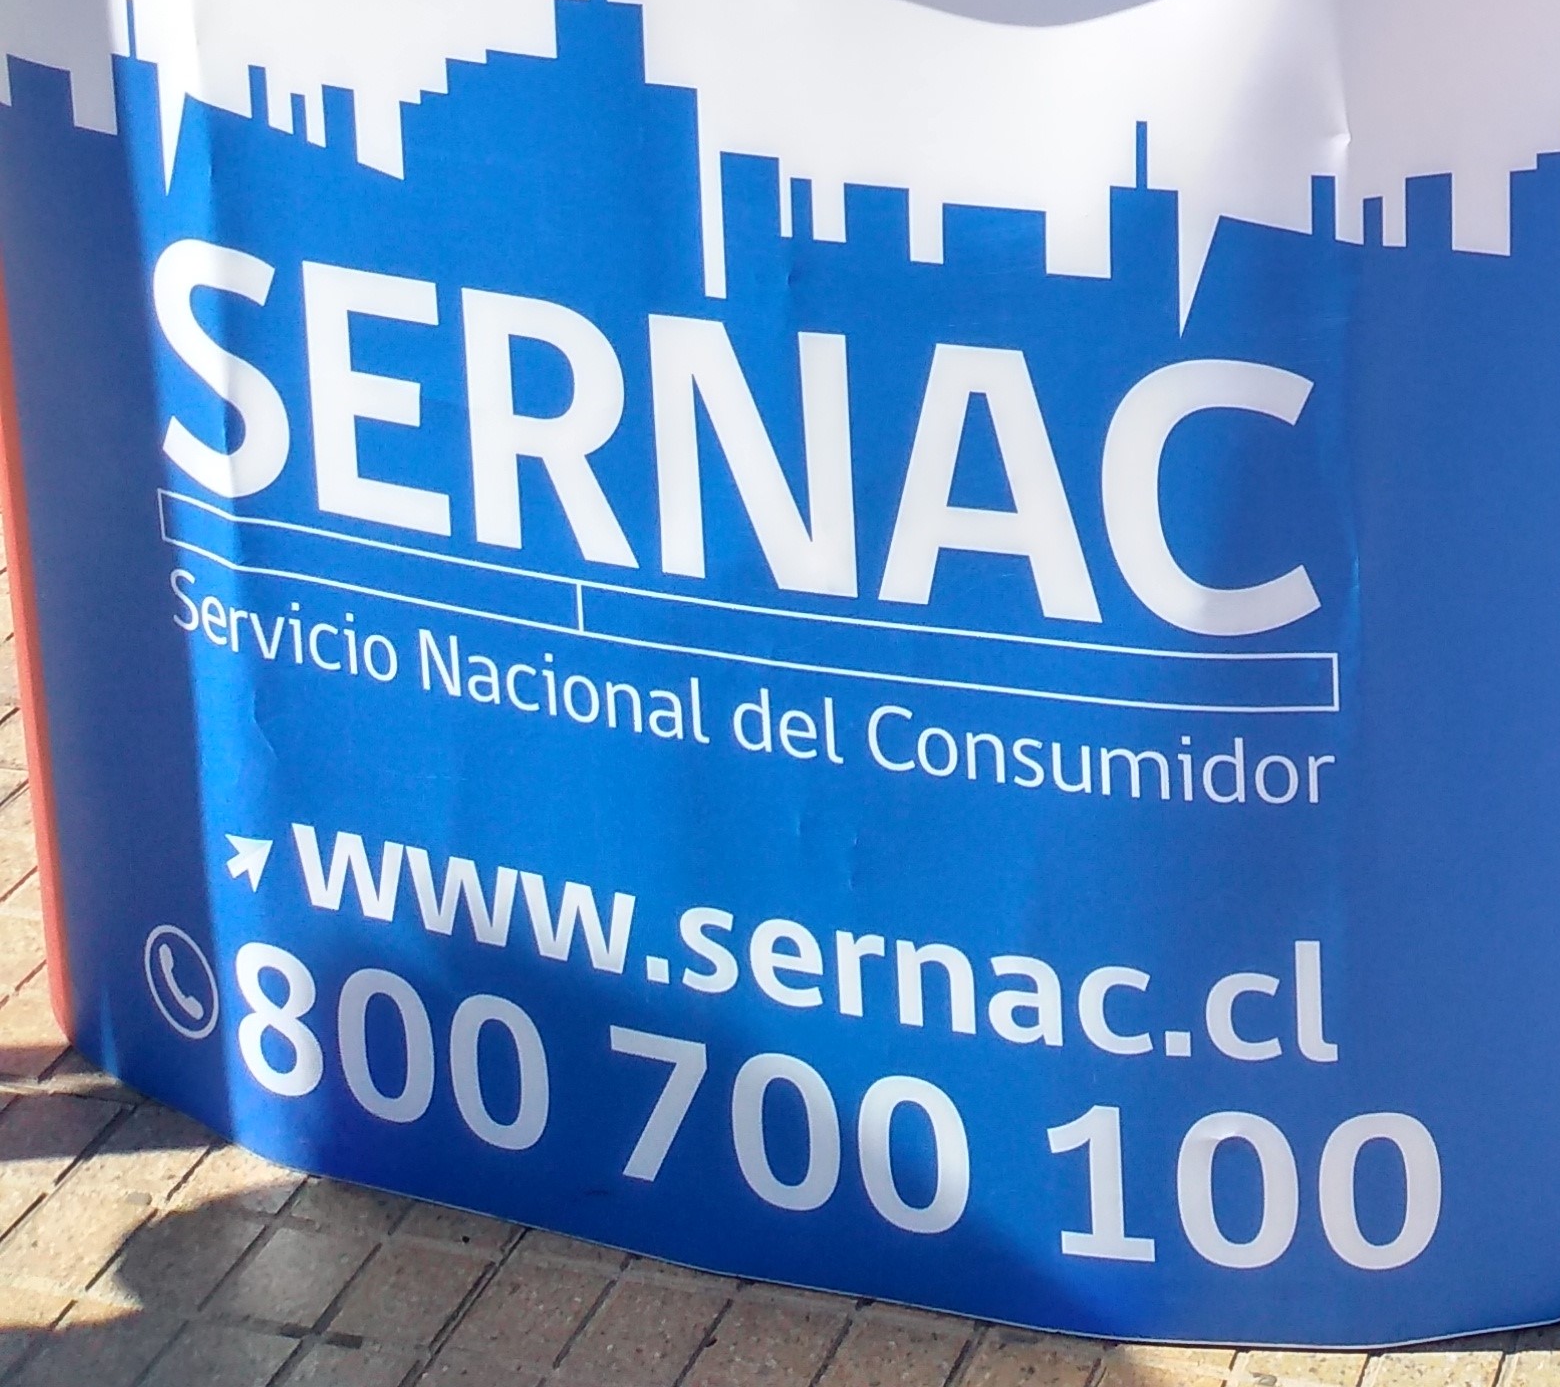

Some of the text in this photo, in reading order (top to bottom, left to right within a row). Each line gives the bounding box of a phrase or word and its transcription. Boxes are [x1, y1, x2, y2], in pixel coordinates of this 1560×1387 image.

[152, 238, 1322, 635] SERNAC
[169, 569, 1336, 805] Servicio Nacional del Consumidor
[291, 821, 1339, 1064] www.sernac.cl
[233, 941, 1444, 1271] 800 700 100
